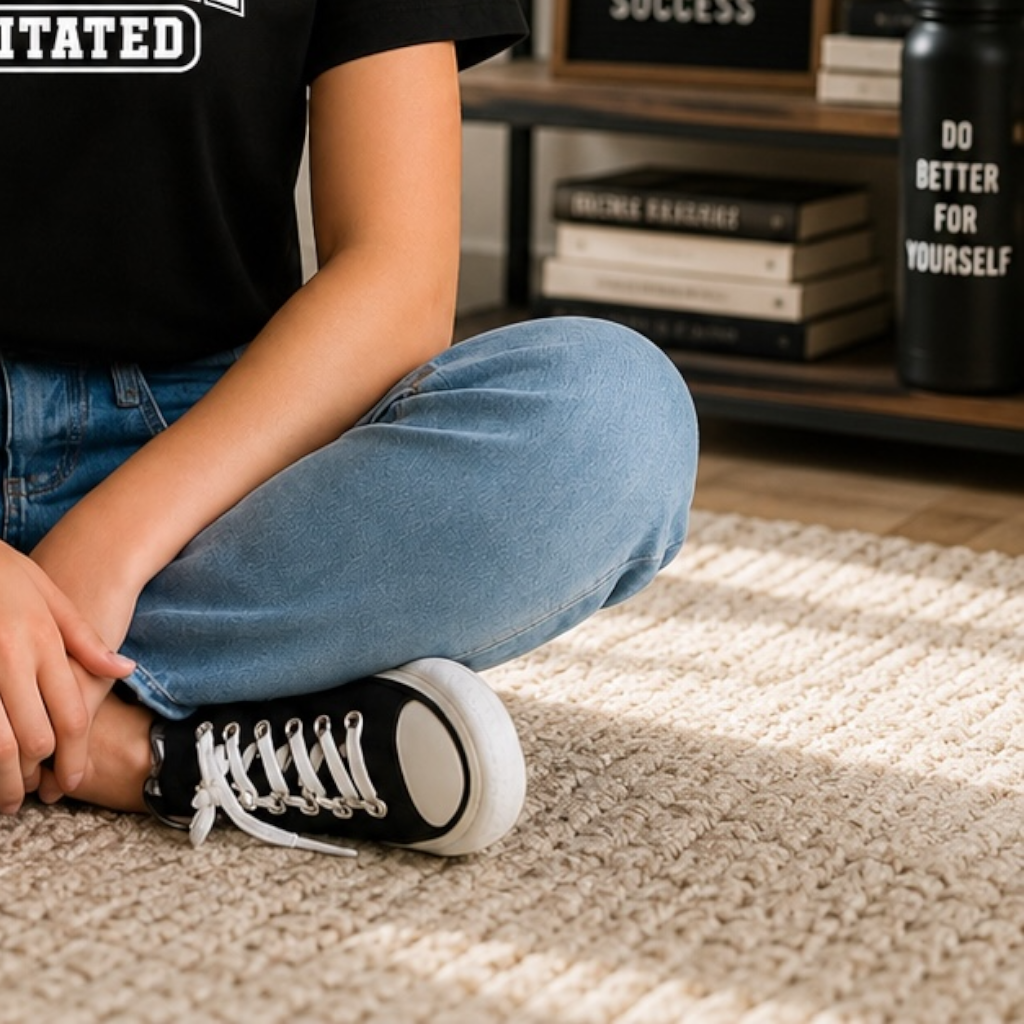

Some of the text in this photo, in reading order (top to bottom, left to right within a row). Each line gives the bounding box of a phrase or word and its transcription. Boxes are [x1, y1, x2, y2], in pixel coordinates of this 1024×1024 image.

[941, 120, 973, 151] DO
[915, 158, 1000, 194] BETTER
[934, 203, 978, 234] FOR
[905, 239, 1012, 277] YOURSELF
